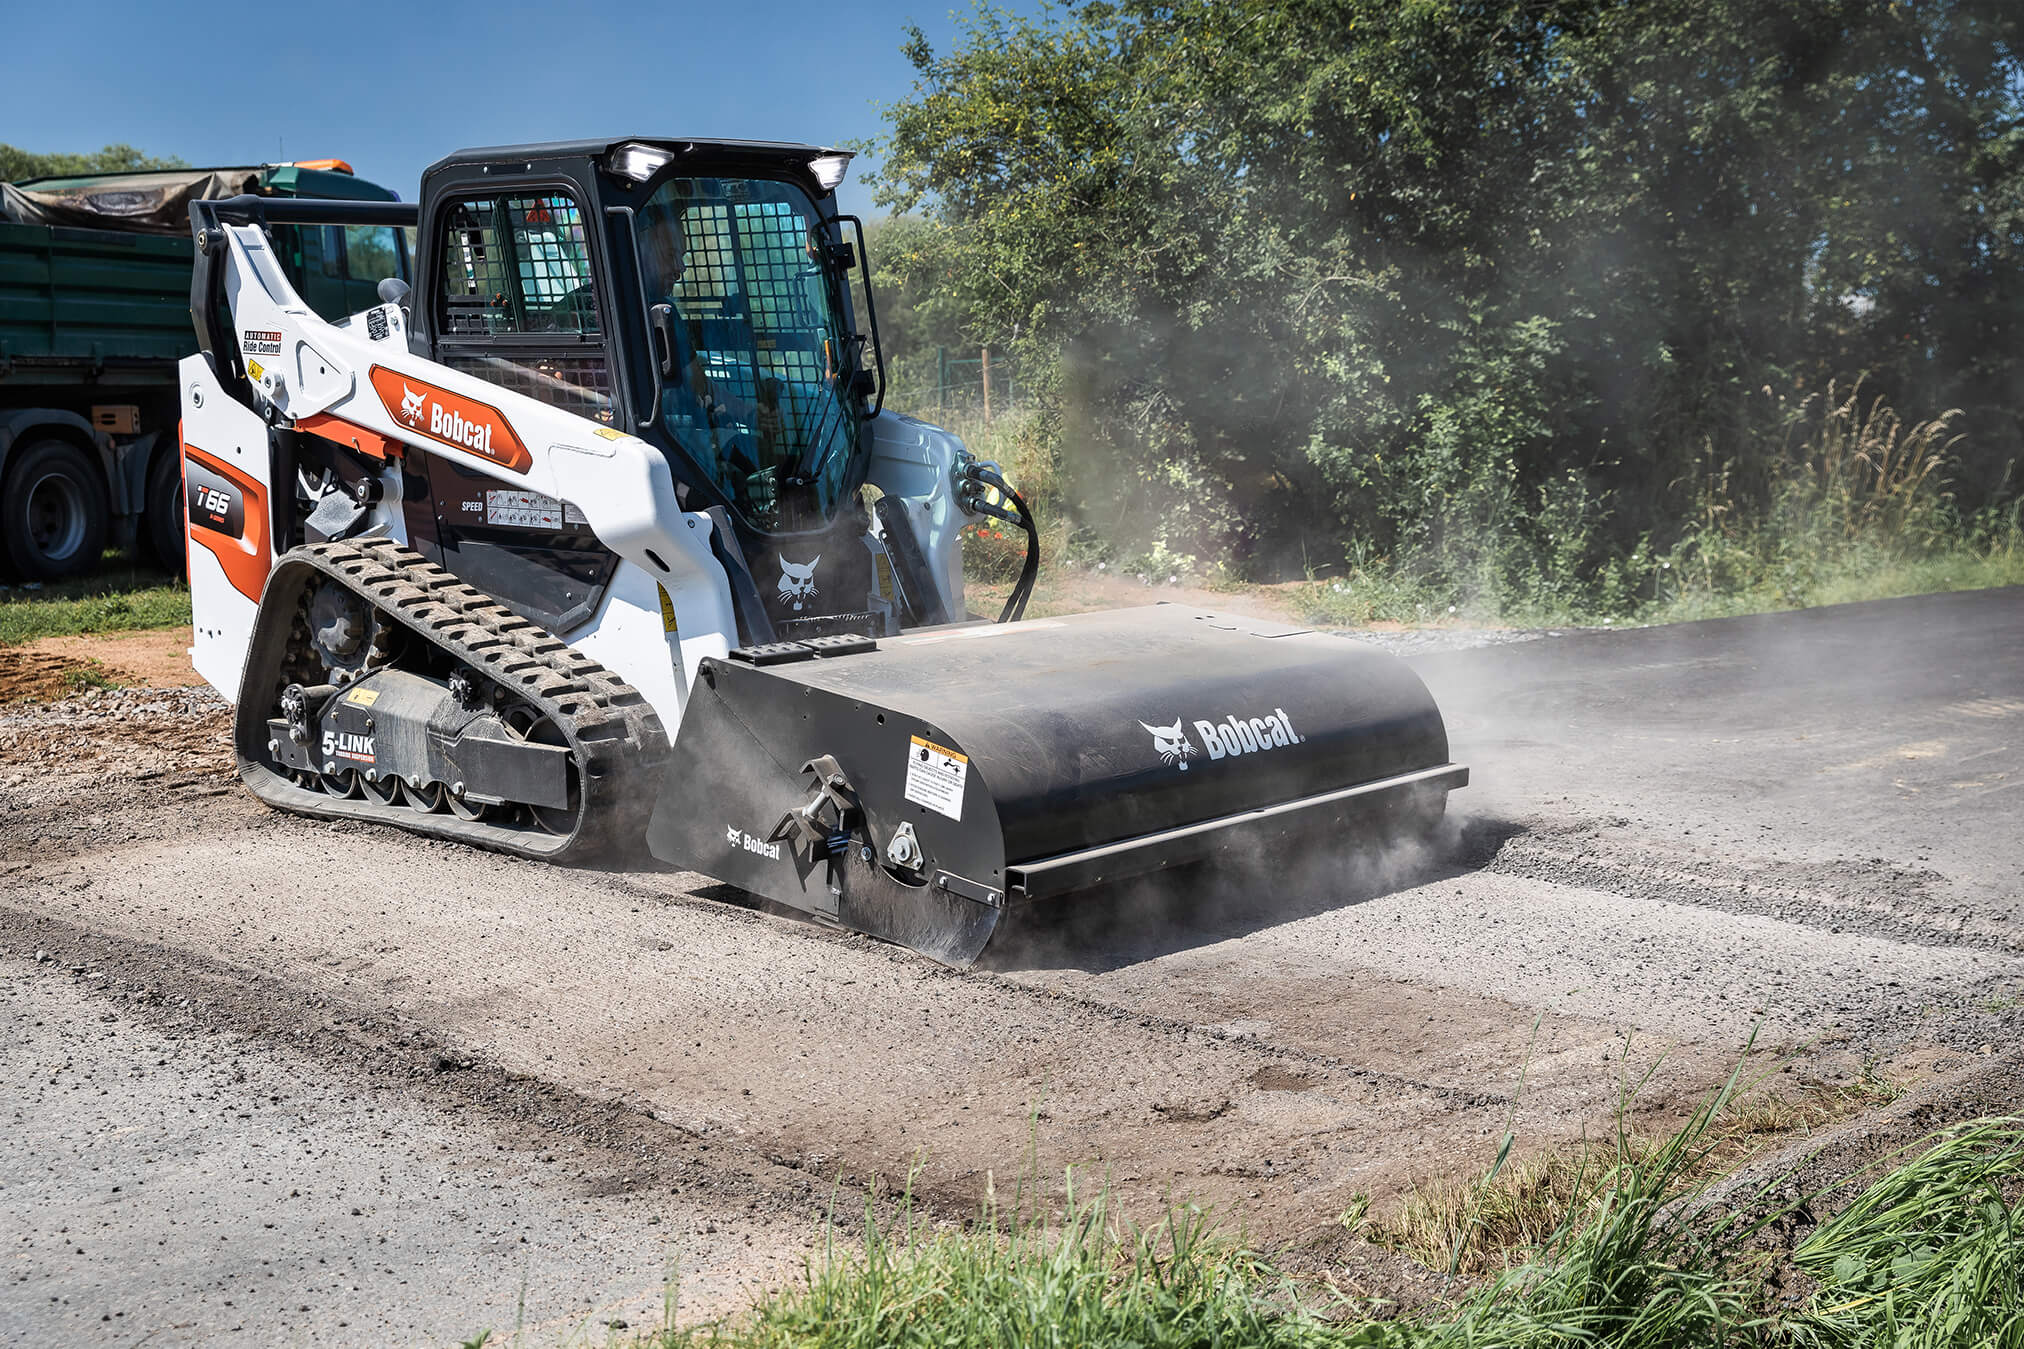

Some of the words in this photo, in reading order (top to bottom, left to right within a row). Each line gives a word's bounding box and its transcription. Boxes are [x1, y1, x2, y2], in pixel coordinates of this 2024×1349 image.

[243, 341, 257, 352] Ride
[258, 342, 281, 353] Control
[245, 332, 281, 340] AUTOMATIC
[430, 402, 492, 455] Bobcat
[197, 485, 231, 515] T66
[462, 501, 482, 511] SPEED
[321, 730, 375, 756] 5-LINK
[1193, 707, 1299, 760] Bobcat
[743, 833, 780, 860] Bobcat
